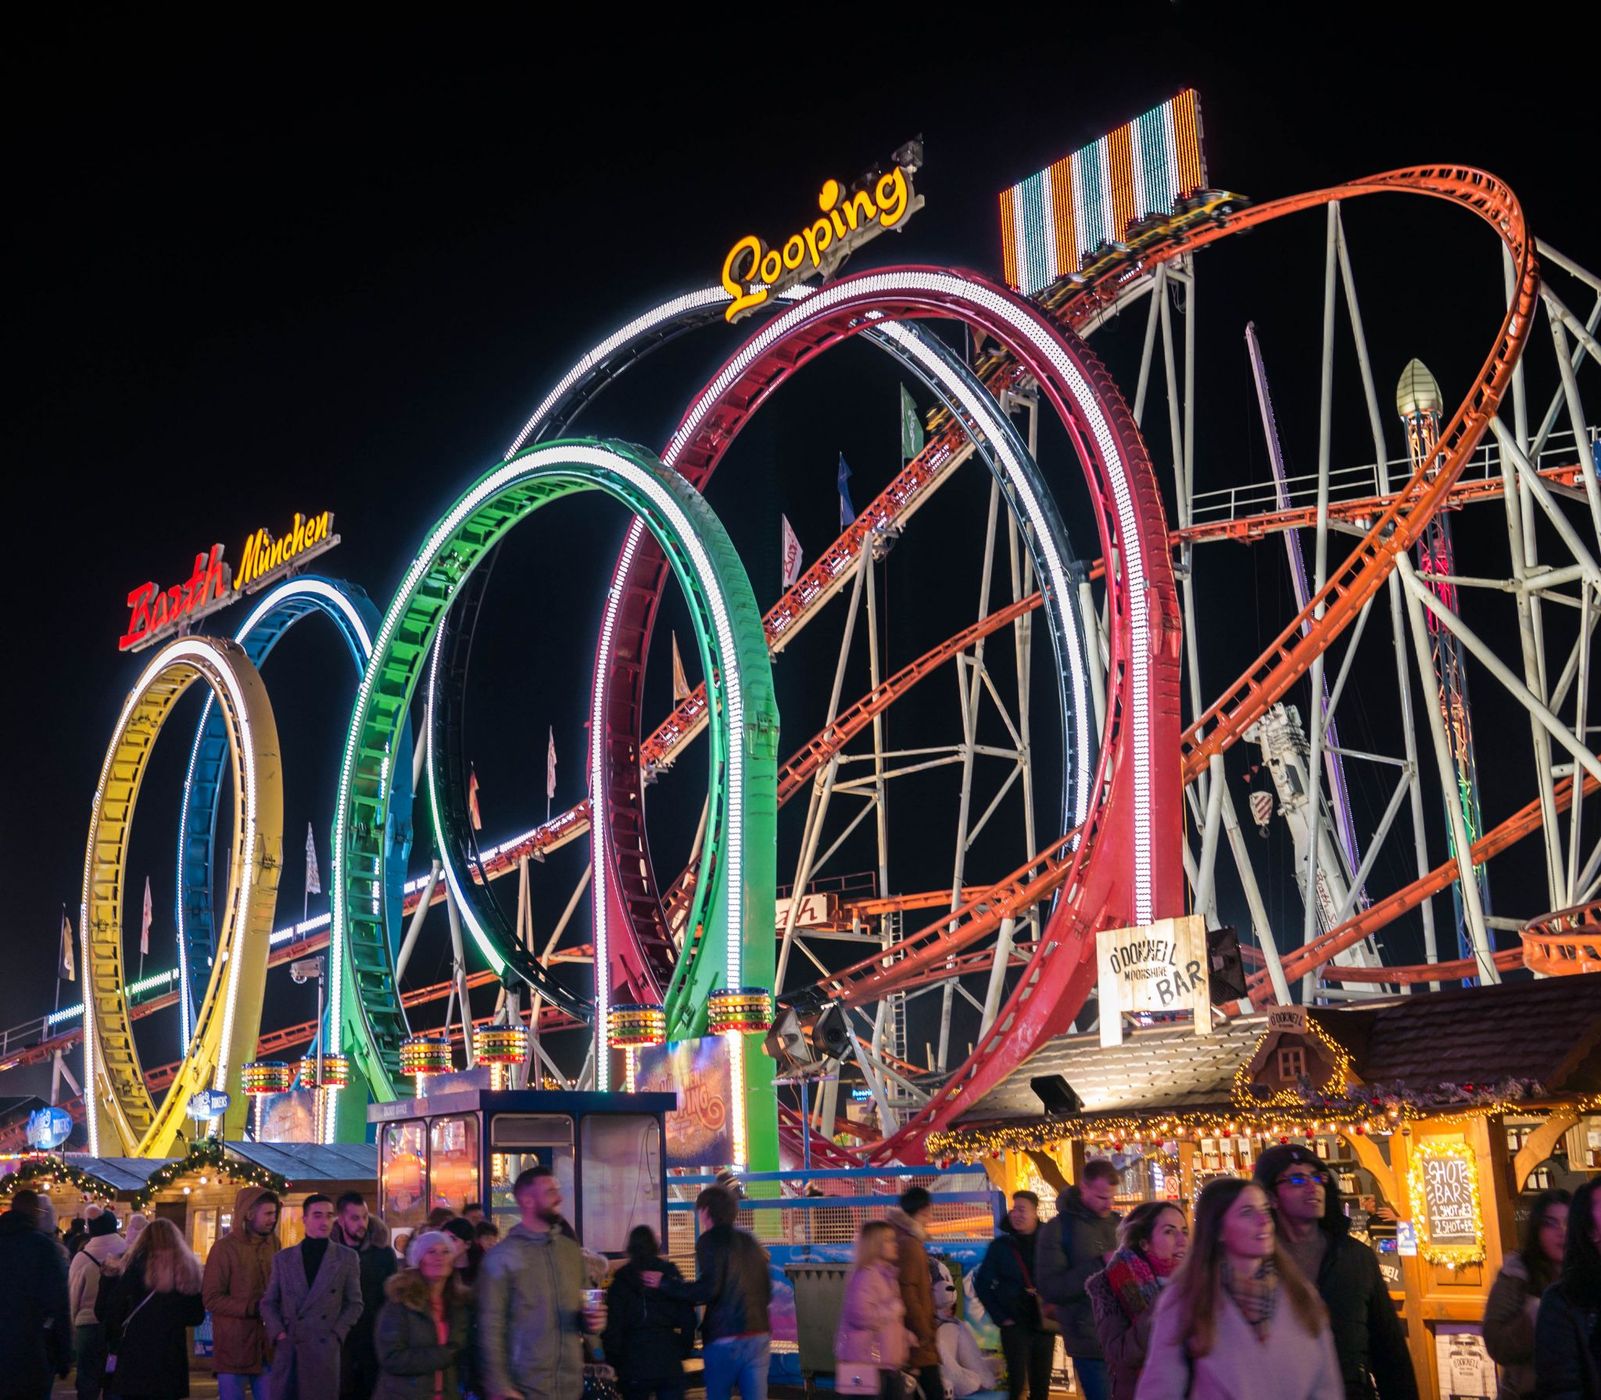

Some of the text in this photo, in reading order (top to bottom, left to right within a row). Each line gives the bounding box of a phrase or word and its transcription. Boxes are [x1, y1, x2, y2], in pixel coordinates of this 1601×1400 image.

[721, 165, 909, 324] Looping
[118, 511, 331, 651] Barth München
[1110, 939, 1177, 975] O'DONNELL
[1124, 966, 1167, 981] MOONSHINE
[1156, 960, 1206, 1007] BAR
[1428, 1160, 1466, 1184] SHOT
[1434, 1182, 1464, 1204] BAR
[1434, 1220, 1441, 1233] 2
